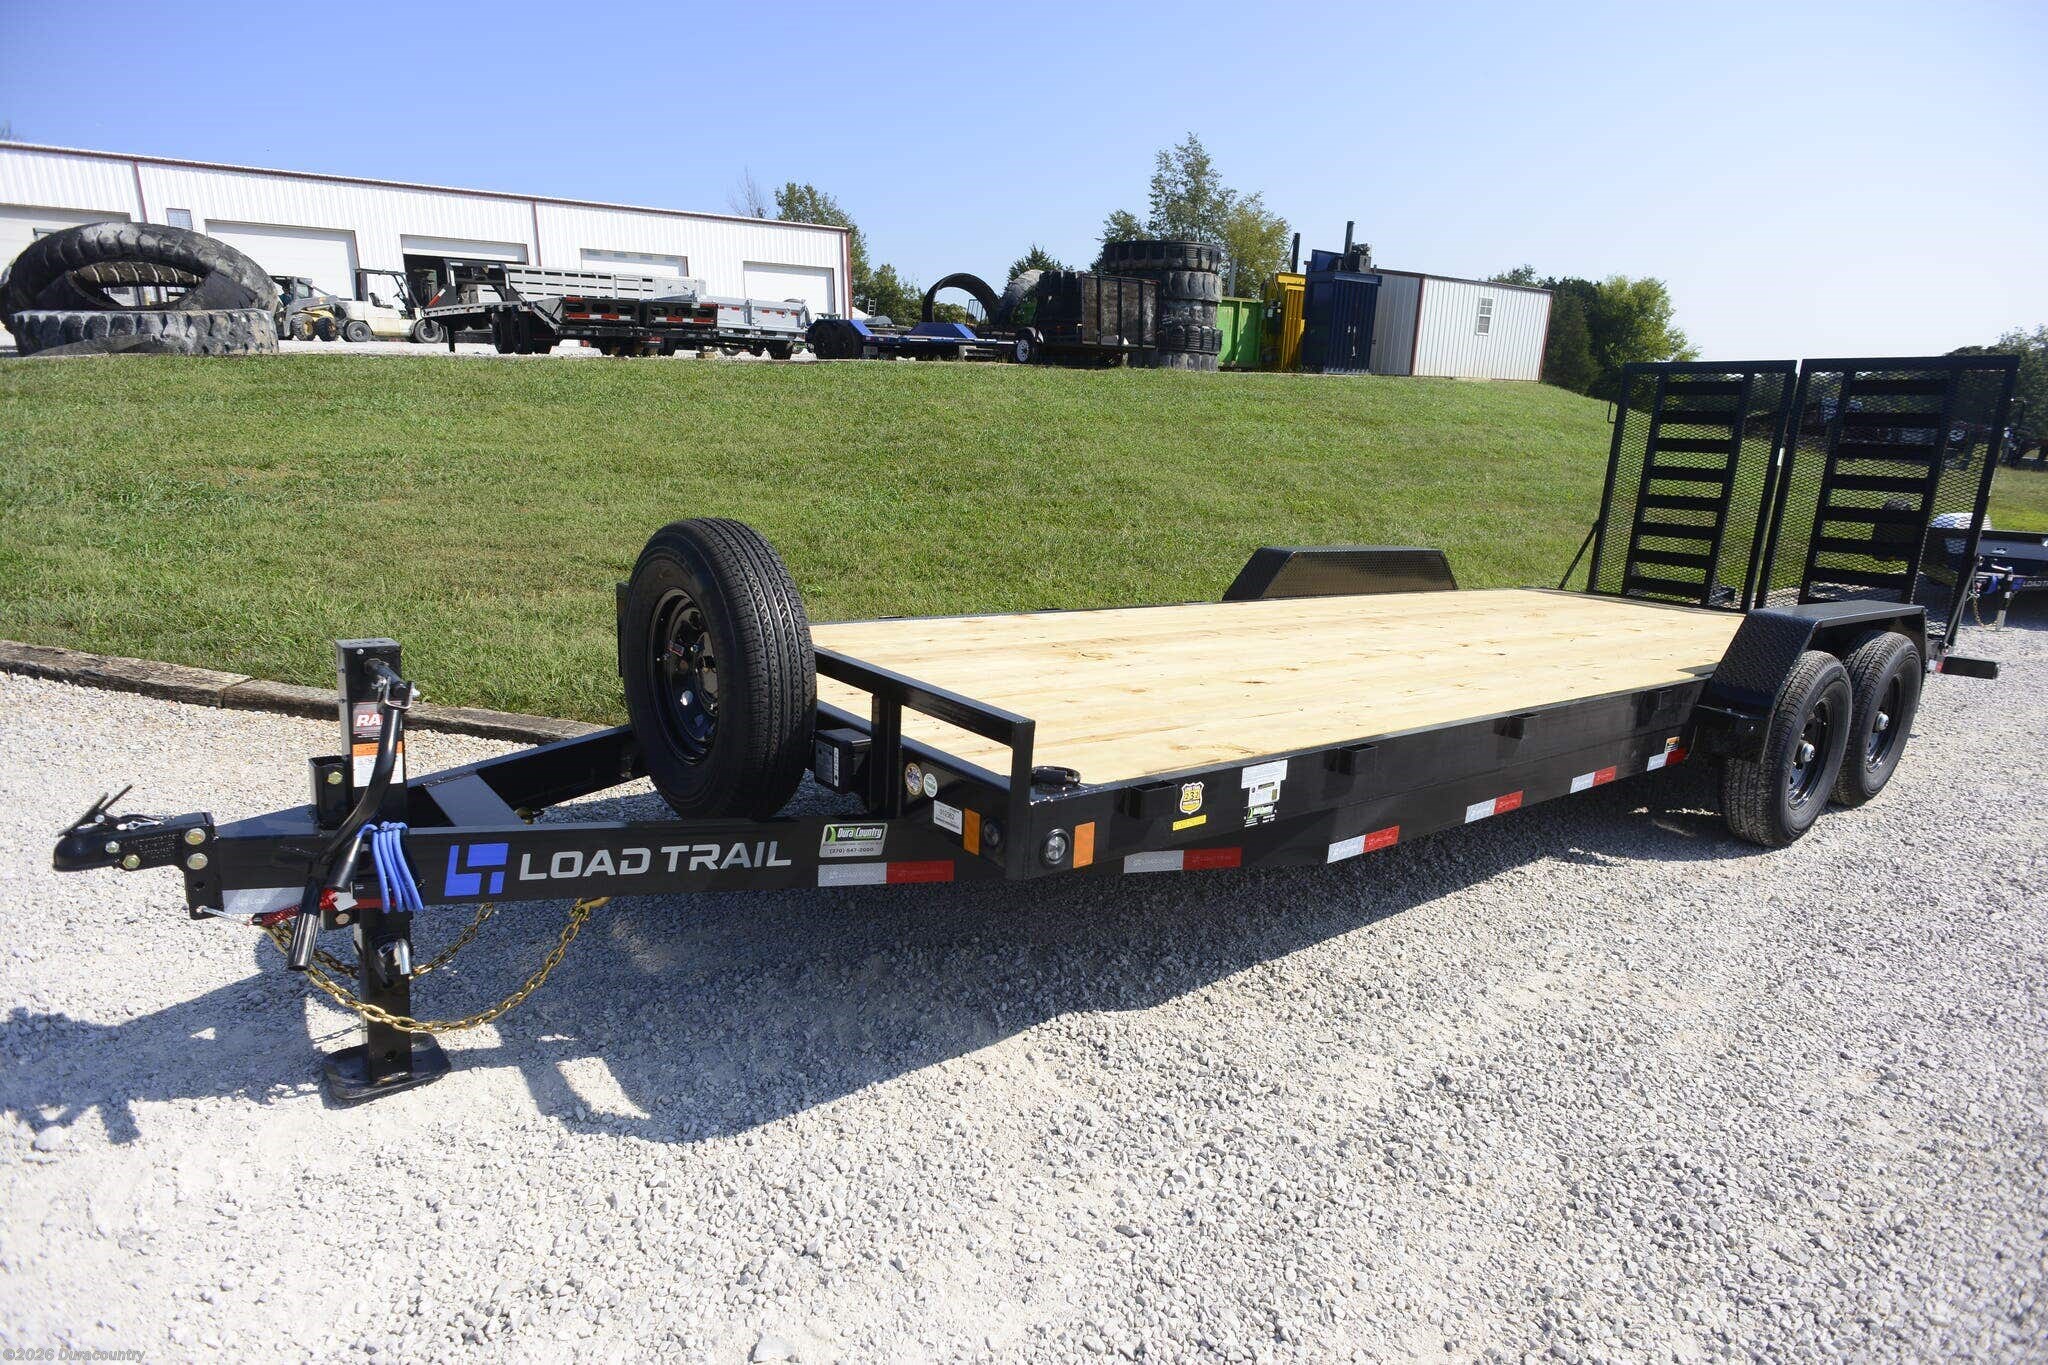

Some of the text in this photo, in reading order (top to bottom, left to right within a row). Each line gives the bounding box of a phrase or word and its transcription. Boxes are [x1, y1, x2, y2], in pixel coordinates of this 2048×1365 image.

[837, 827, 883, 839] Dura Country
[520, 840, 793, 882] LOAD TRAIL
